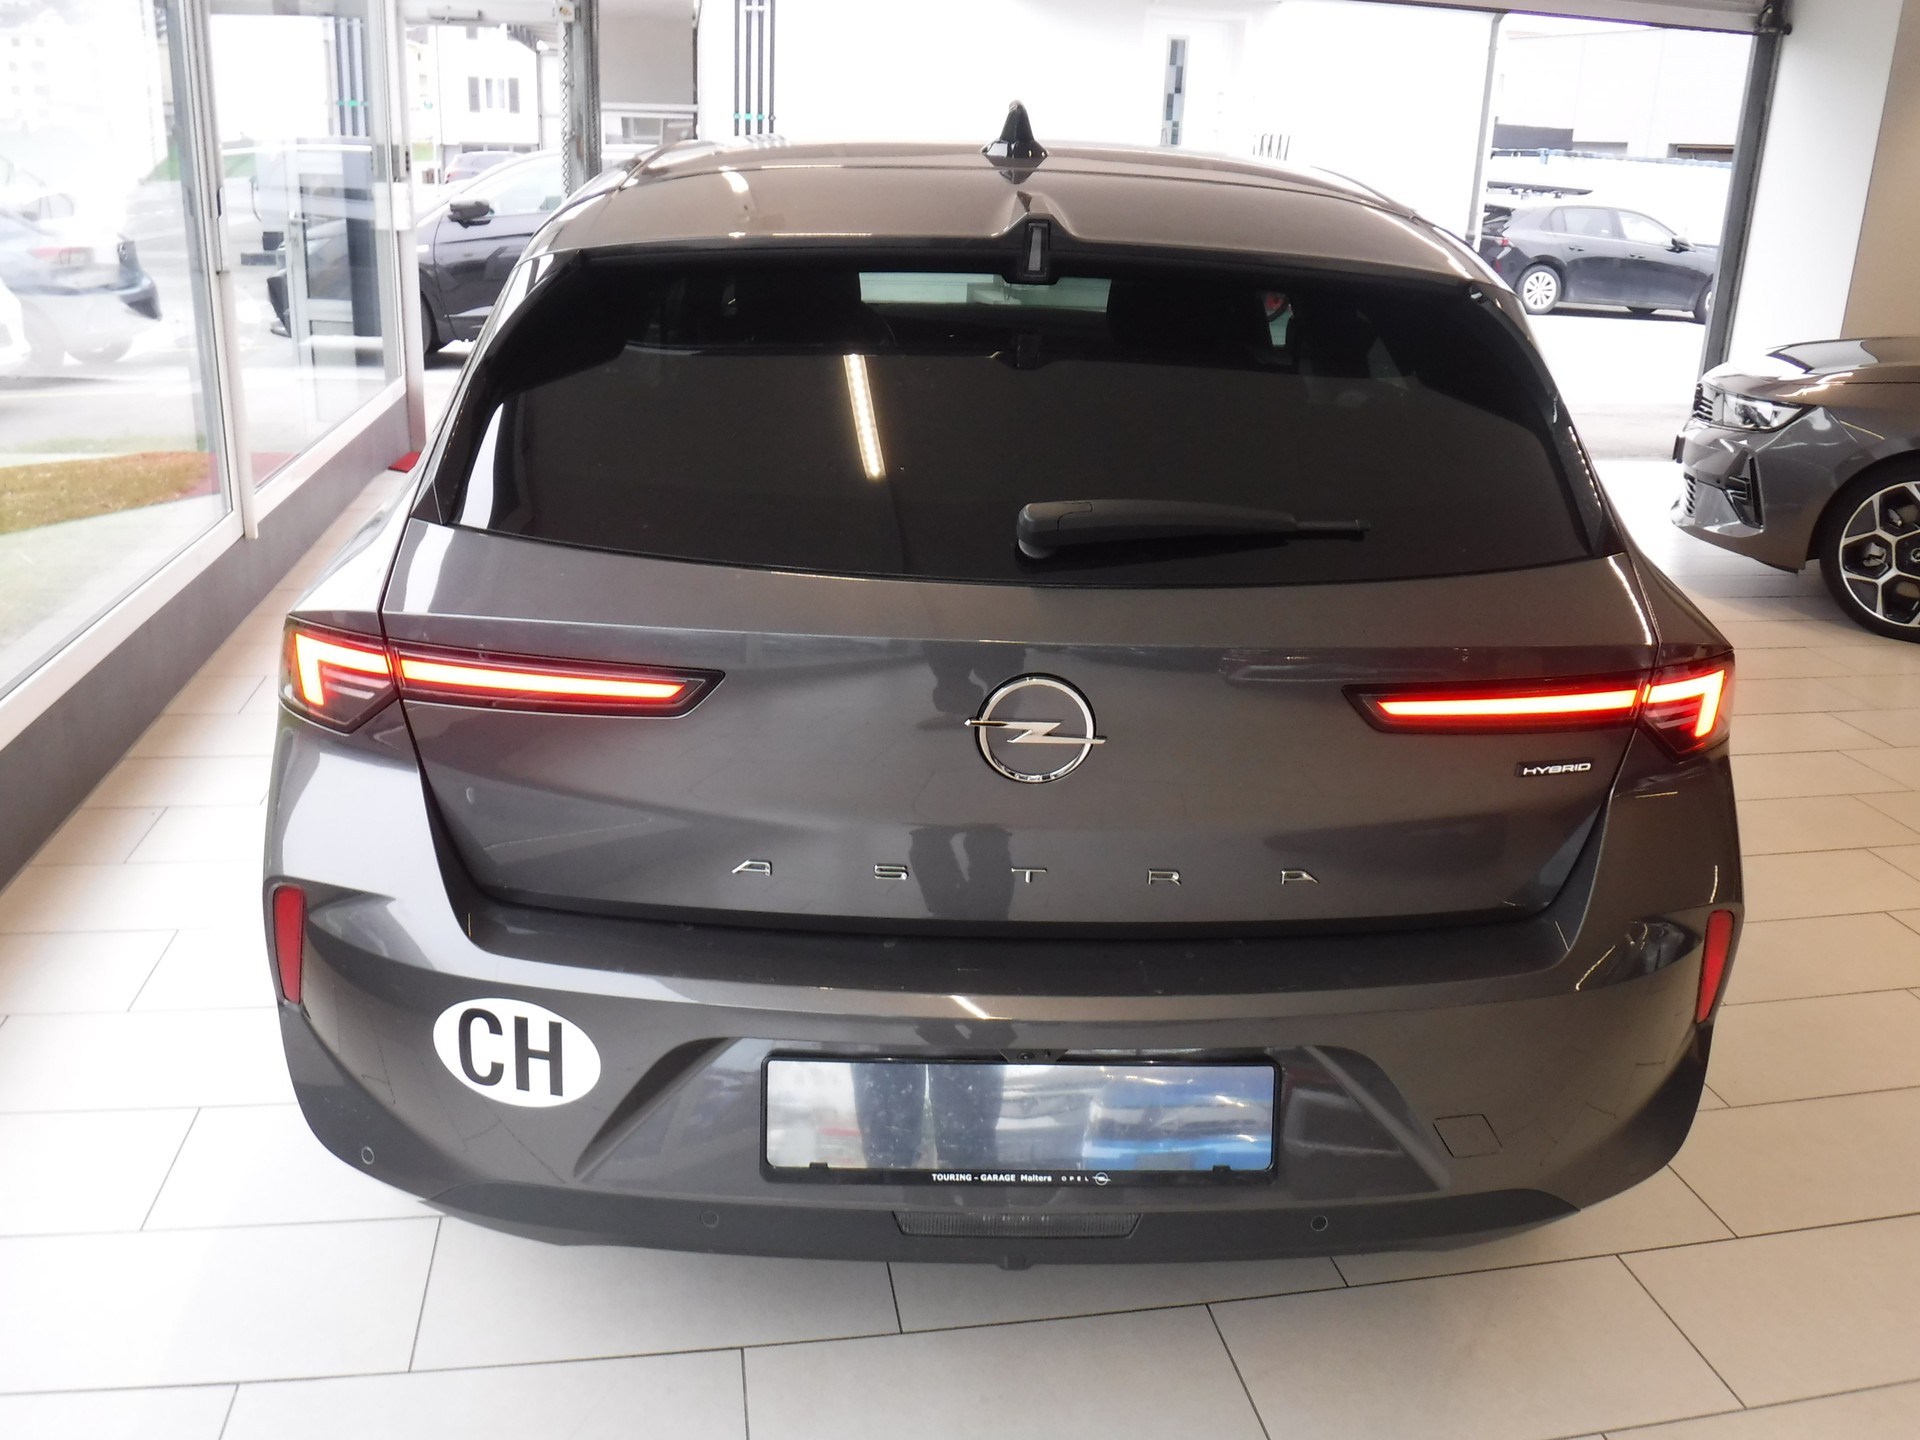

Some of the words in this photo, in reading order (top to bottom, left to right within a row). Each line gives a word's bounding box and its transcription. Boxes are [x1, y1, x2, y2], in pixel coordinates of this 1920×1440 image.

[1522, 762, 1592, 776] HYBRID
[730, 858, 1320, 887] ASTRA
[458, 1007, 564, 1097] CH
[931, 1173, 972, 1182] TOURING
[980, 1173, 1016, 1182] GARAGE
